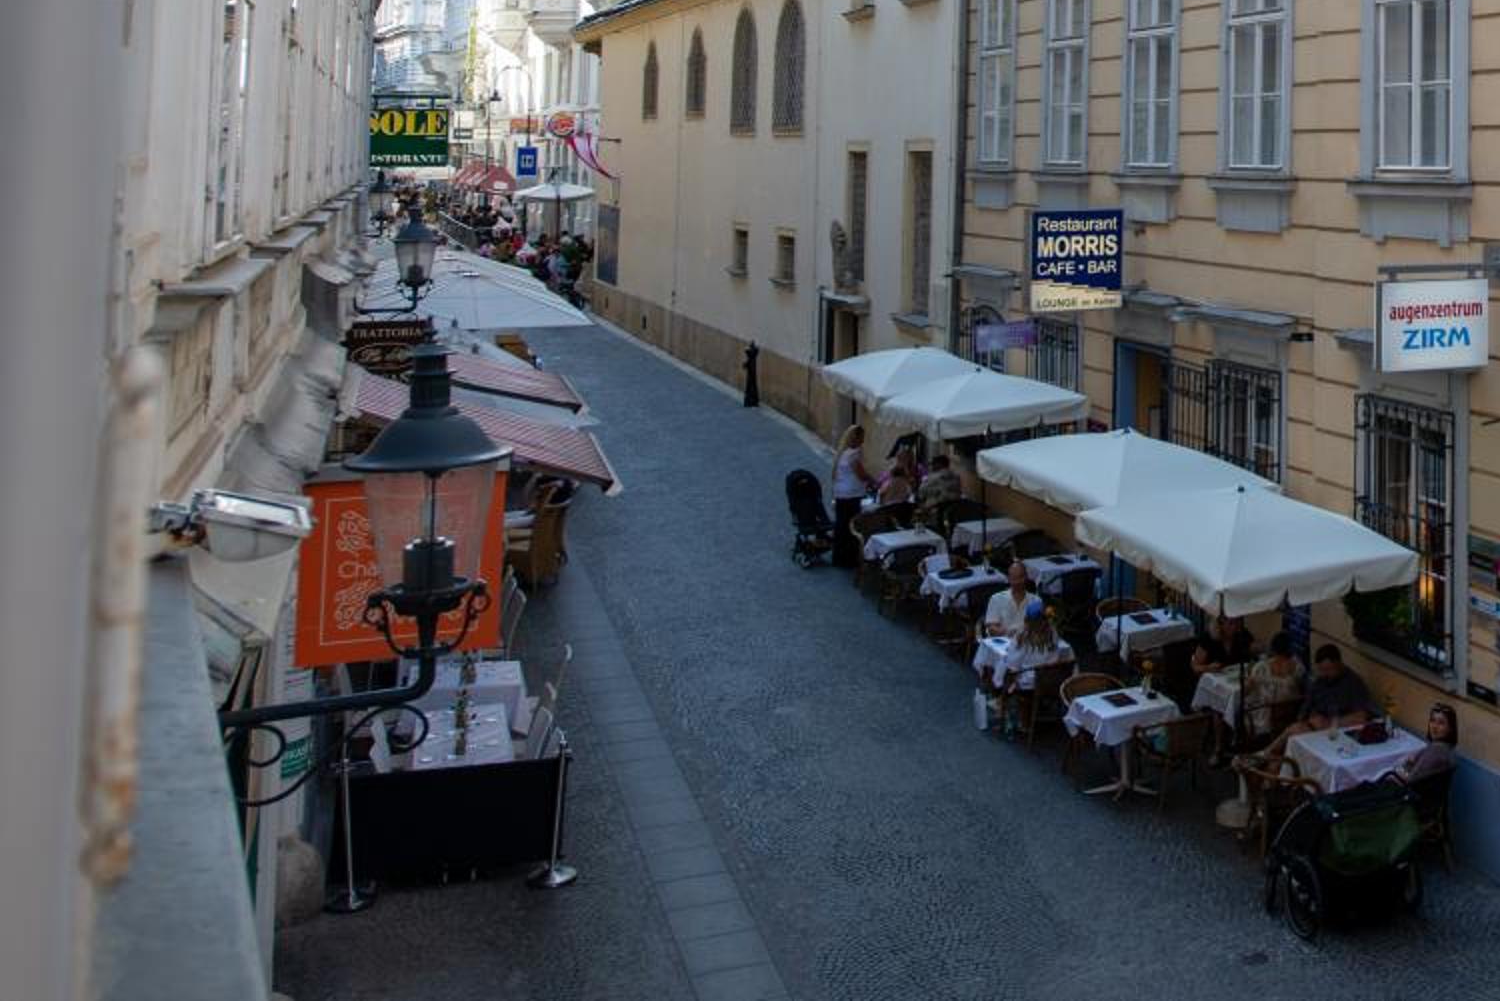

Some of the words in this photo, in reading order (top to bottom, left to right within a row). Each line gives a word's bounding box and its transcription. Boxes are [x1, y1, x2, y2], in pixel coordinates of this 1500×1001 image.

[372, 154, 446, 164] ISTORANTE
[1037, 216, 1117, 232] Restaurant
[1037, 235, 1119, 257] MORRIS
[1037, 260, 1076, 276] CAFE
[1087, 259, 1117, 275] BAR
[1388, 301, 1483, 324] augenzentrum
[352, 326, 422, 339] TRATTORIA
[1402, 326, 1471, 350] ZIRM
